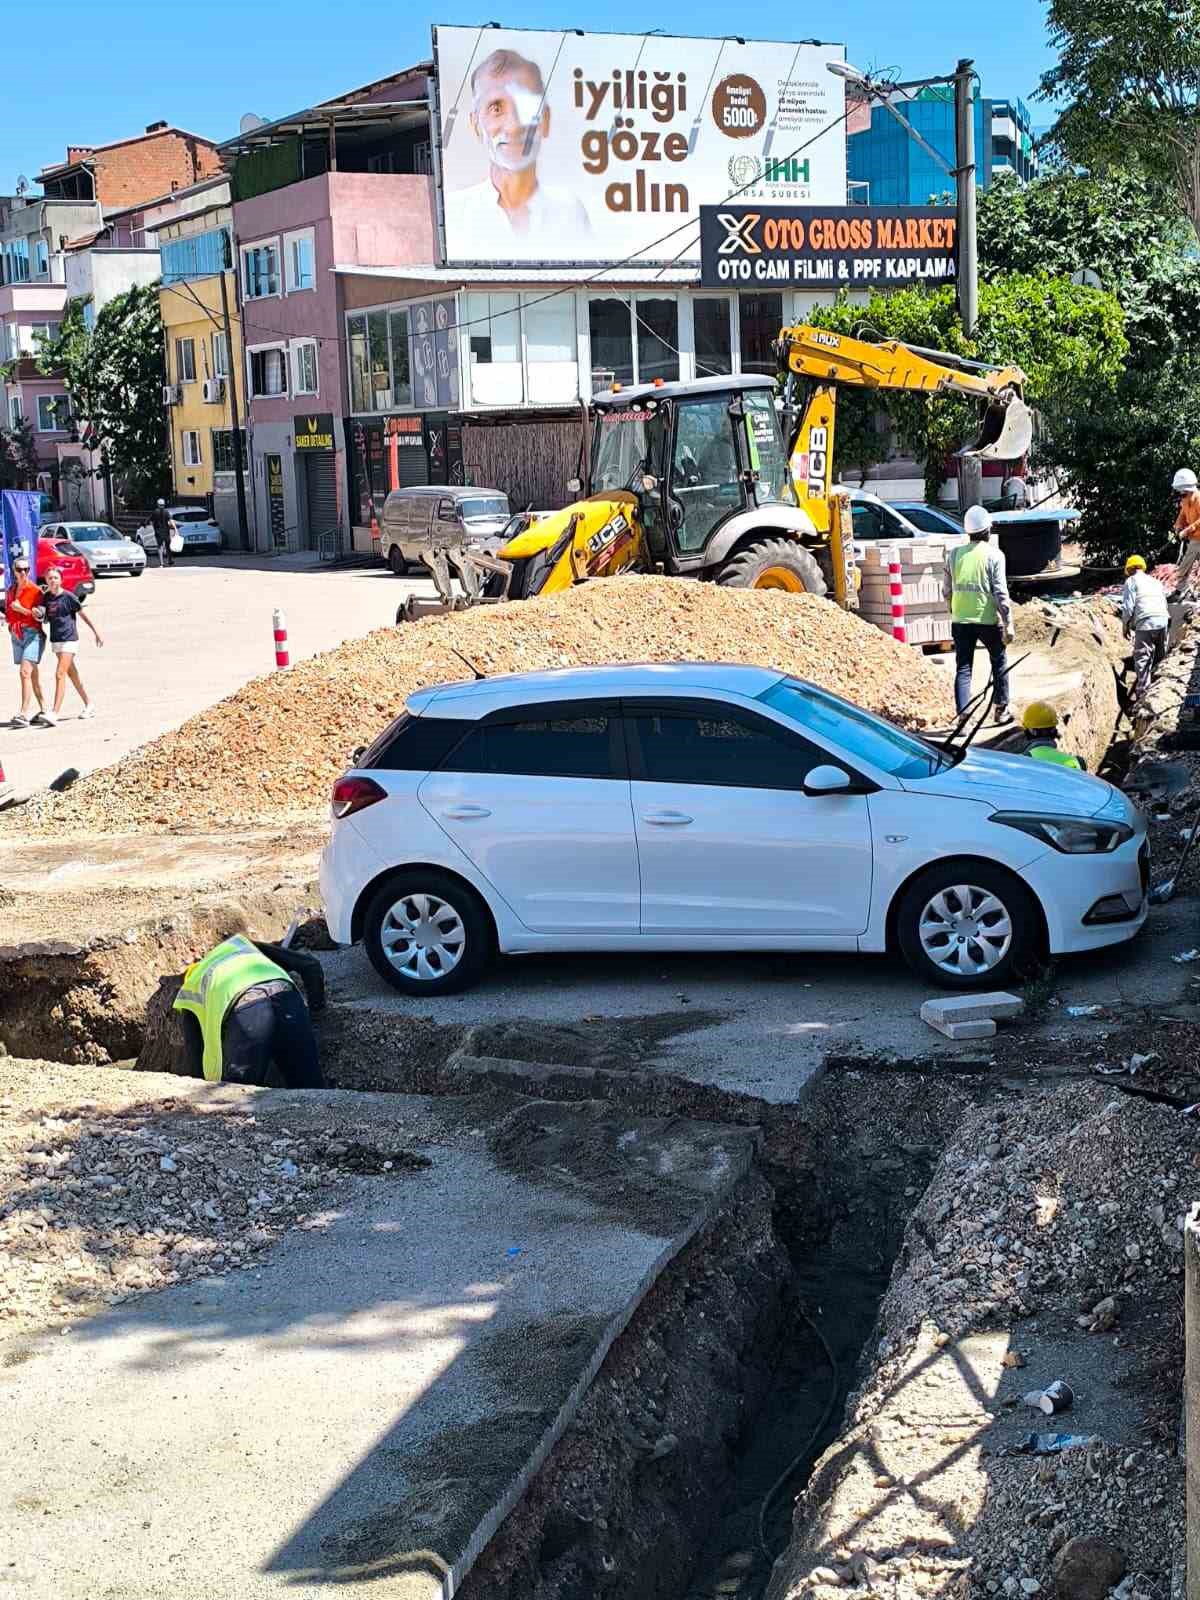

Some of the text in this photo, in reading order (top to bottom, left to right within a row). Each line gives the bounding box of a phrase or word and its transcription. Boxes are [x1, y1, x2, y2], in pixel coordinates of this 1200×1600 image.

[573, 67, 687, 123] iyiliği
[581, 117, 689, 175] göze
[605, 169, 689, 212] alın
[764, 219, 805, 249] OTO
[809, 219, 872, 249] GROSS
[876, 218, 956, 249] MARKET
[718, 260, 751, 280] OTO
[755, 259, 790, 280] CAM
[838, 259, 849, 280] &
[853, 259, 882, 279] PPF
[888, 257, 956, 278] KAPLAMA
[808, 427, 827, 500] JCB
[588, 514, 628, 552] JCB
